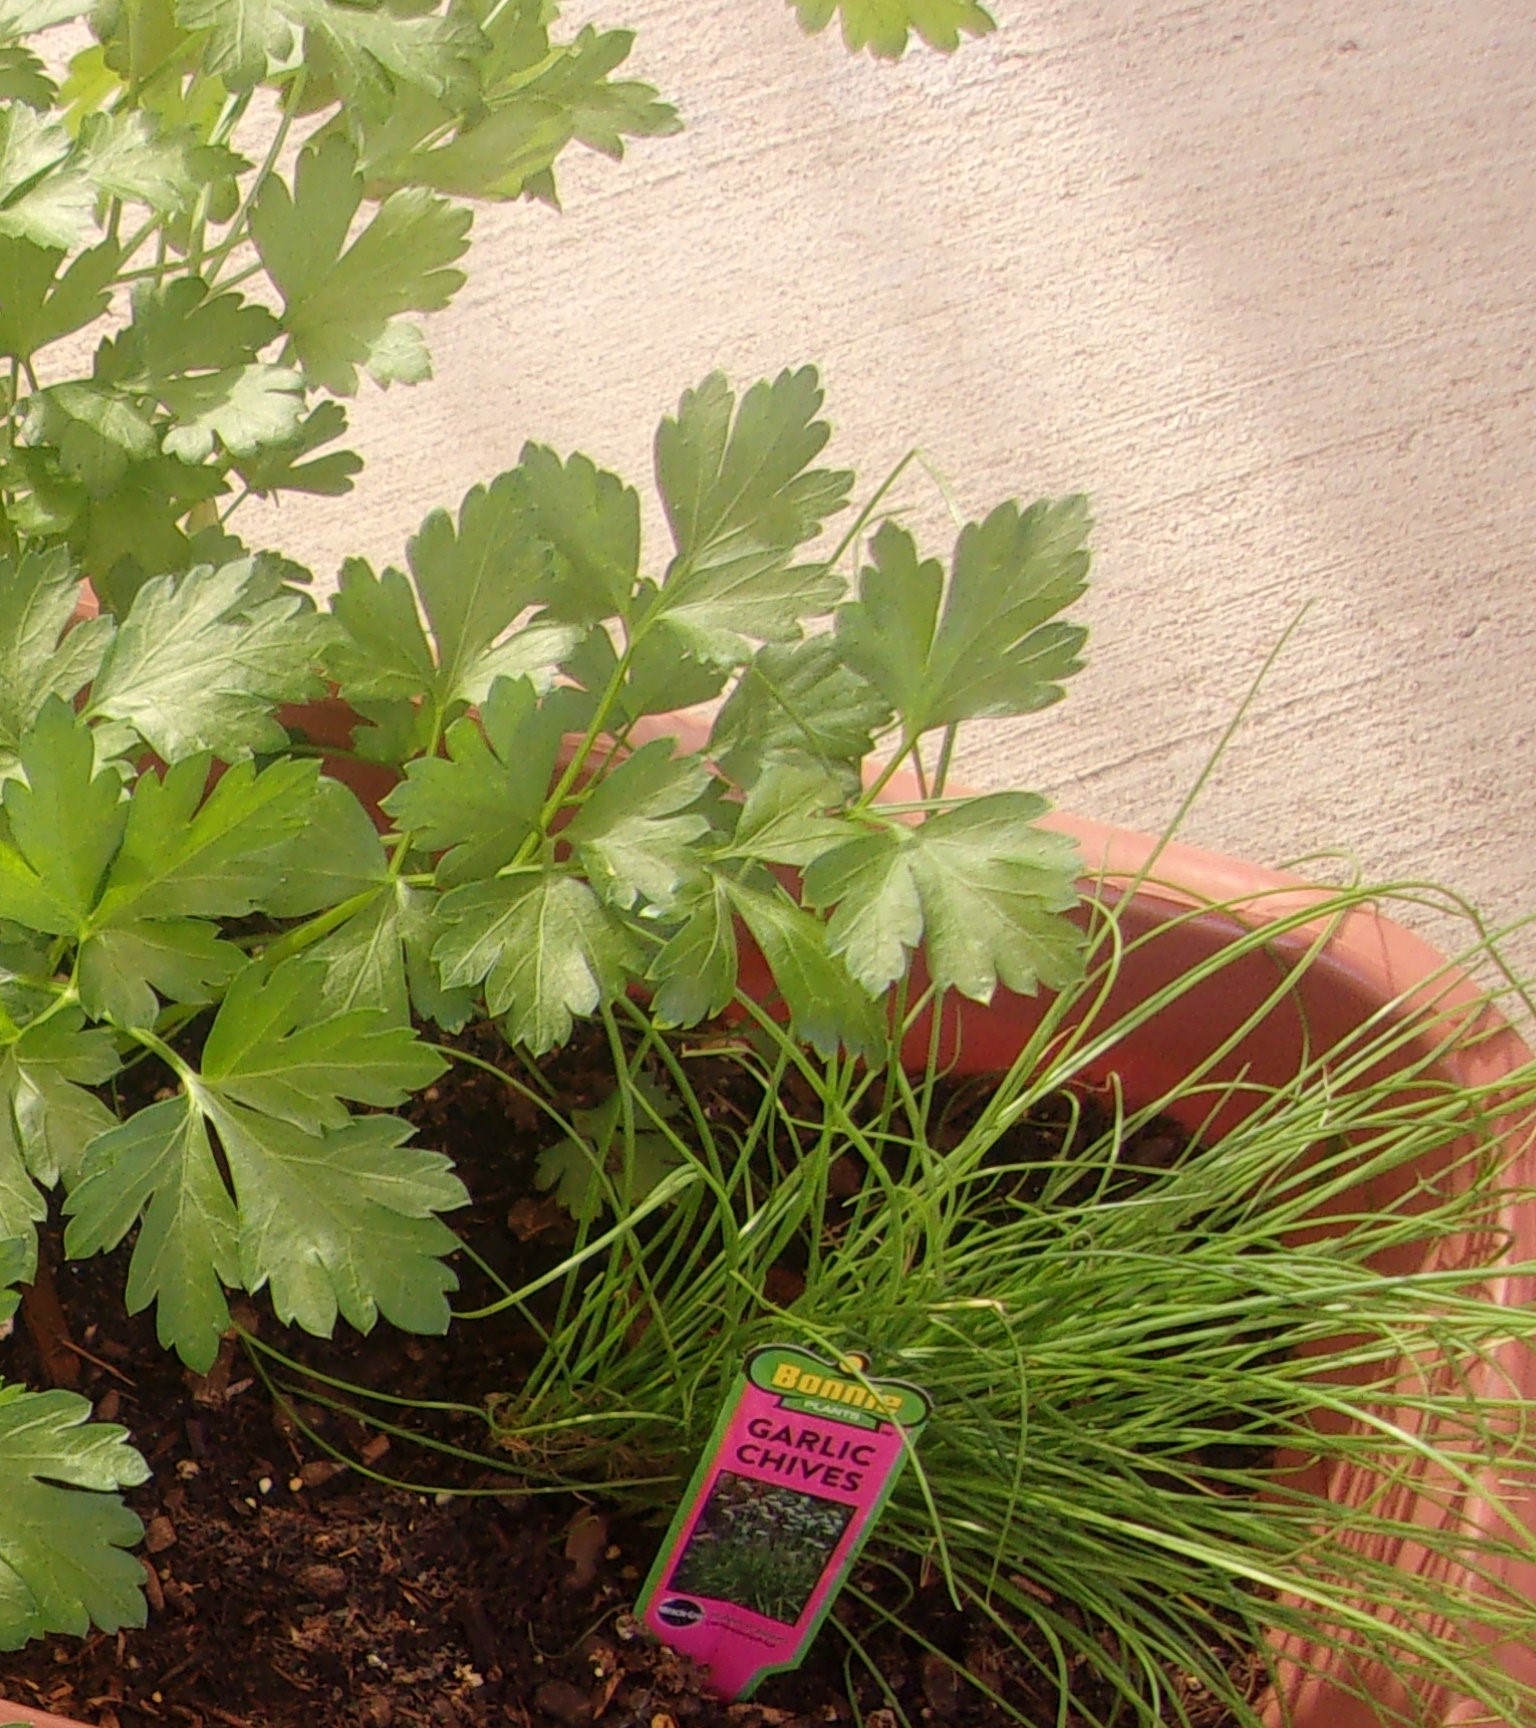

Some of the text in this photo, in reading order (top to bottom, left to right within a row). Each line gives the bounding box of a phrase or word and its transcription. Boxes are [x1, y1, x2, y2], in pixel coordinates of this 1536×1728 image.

[802, 1399, 862, 1421] PLANTS
[748, 1417, 878, 1468] GARLIC
[736, 1443, 865, 1494] CHIVES
